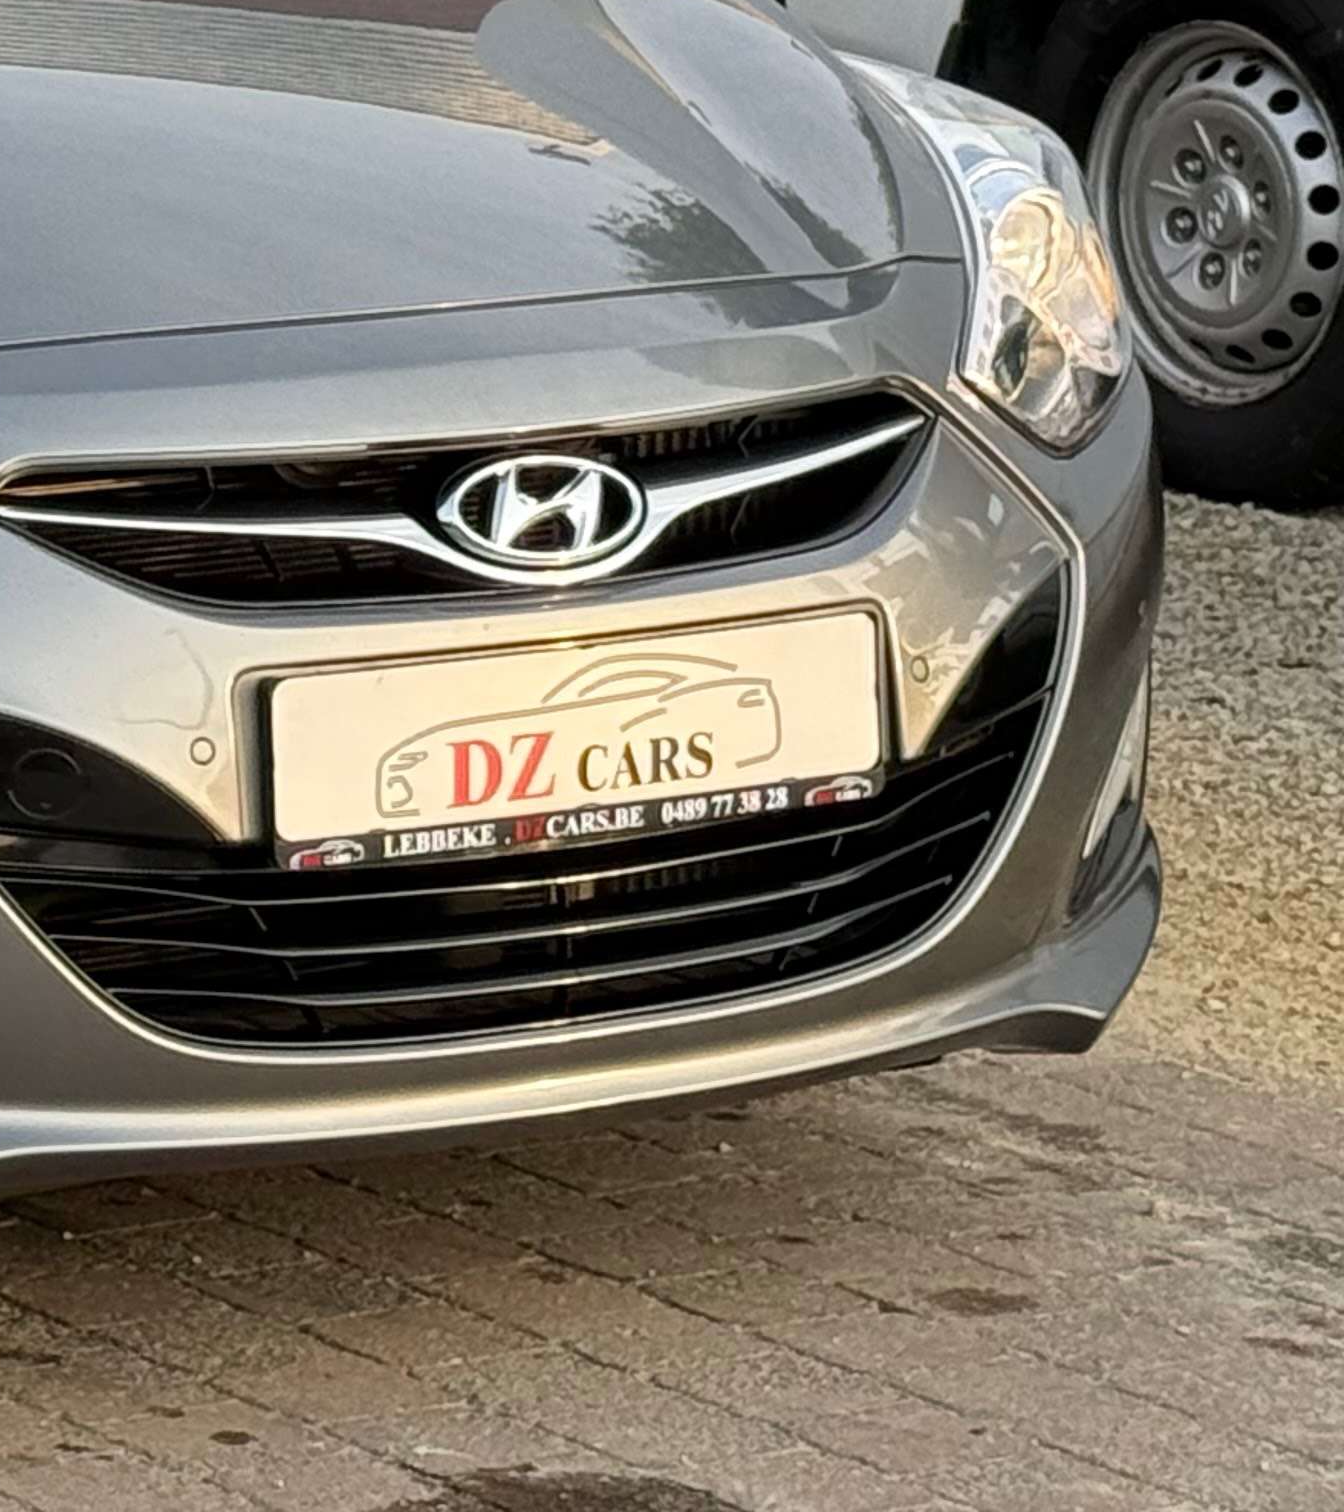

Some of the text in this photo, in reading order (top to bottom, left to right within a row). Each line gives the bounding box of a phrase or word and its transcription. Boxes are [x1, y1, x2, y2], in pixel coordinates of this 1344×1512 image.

[446, 730, 714, 809] DZ CARS
[383, 823, 496, 858] LEBBEKE
[661, 796, 707, 824] 0489
[711, 792, 734, 818] 77
[737, 789, 761, 814] 38
[764, 786, 789, 810] 28
